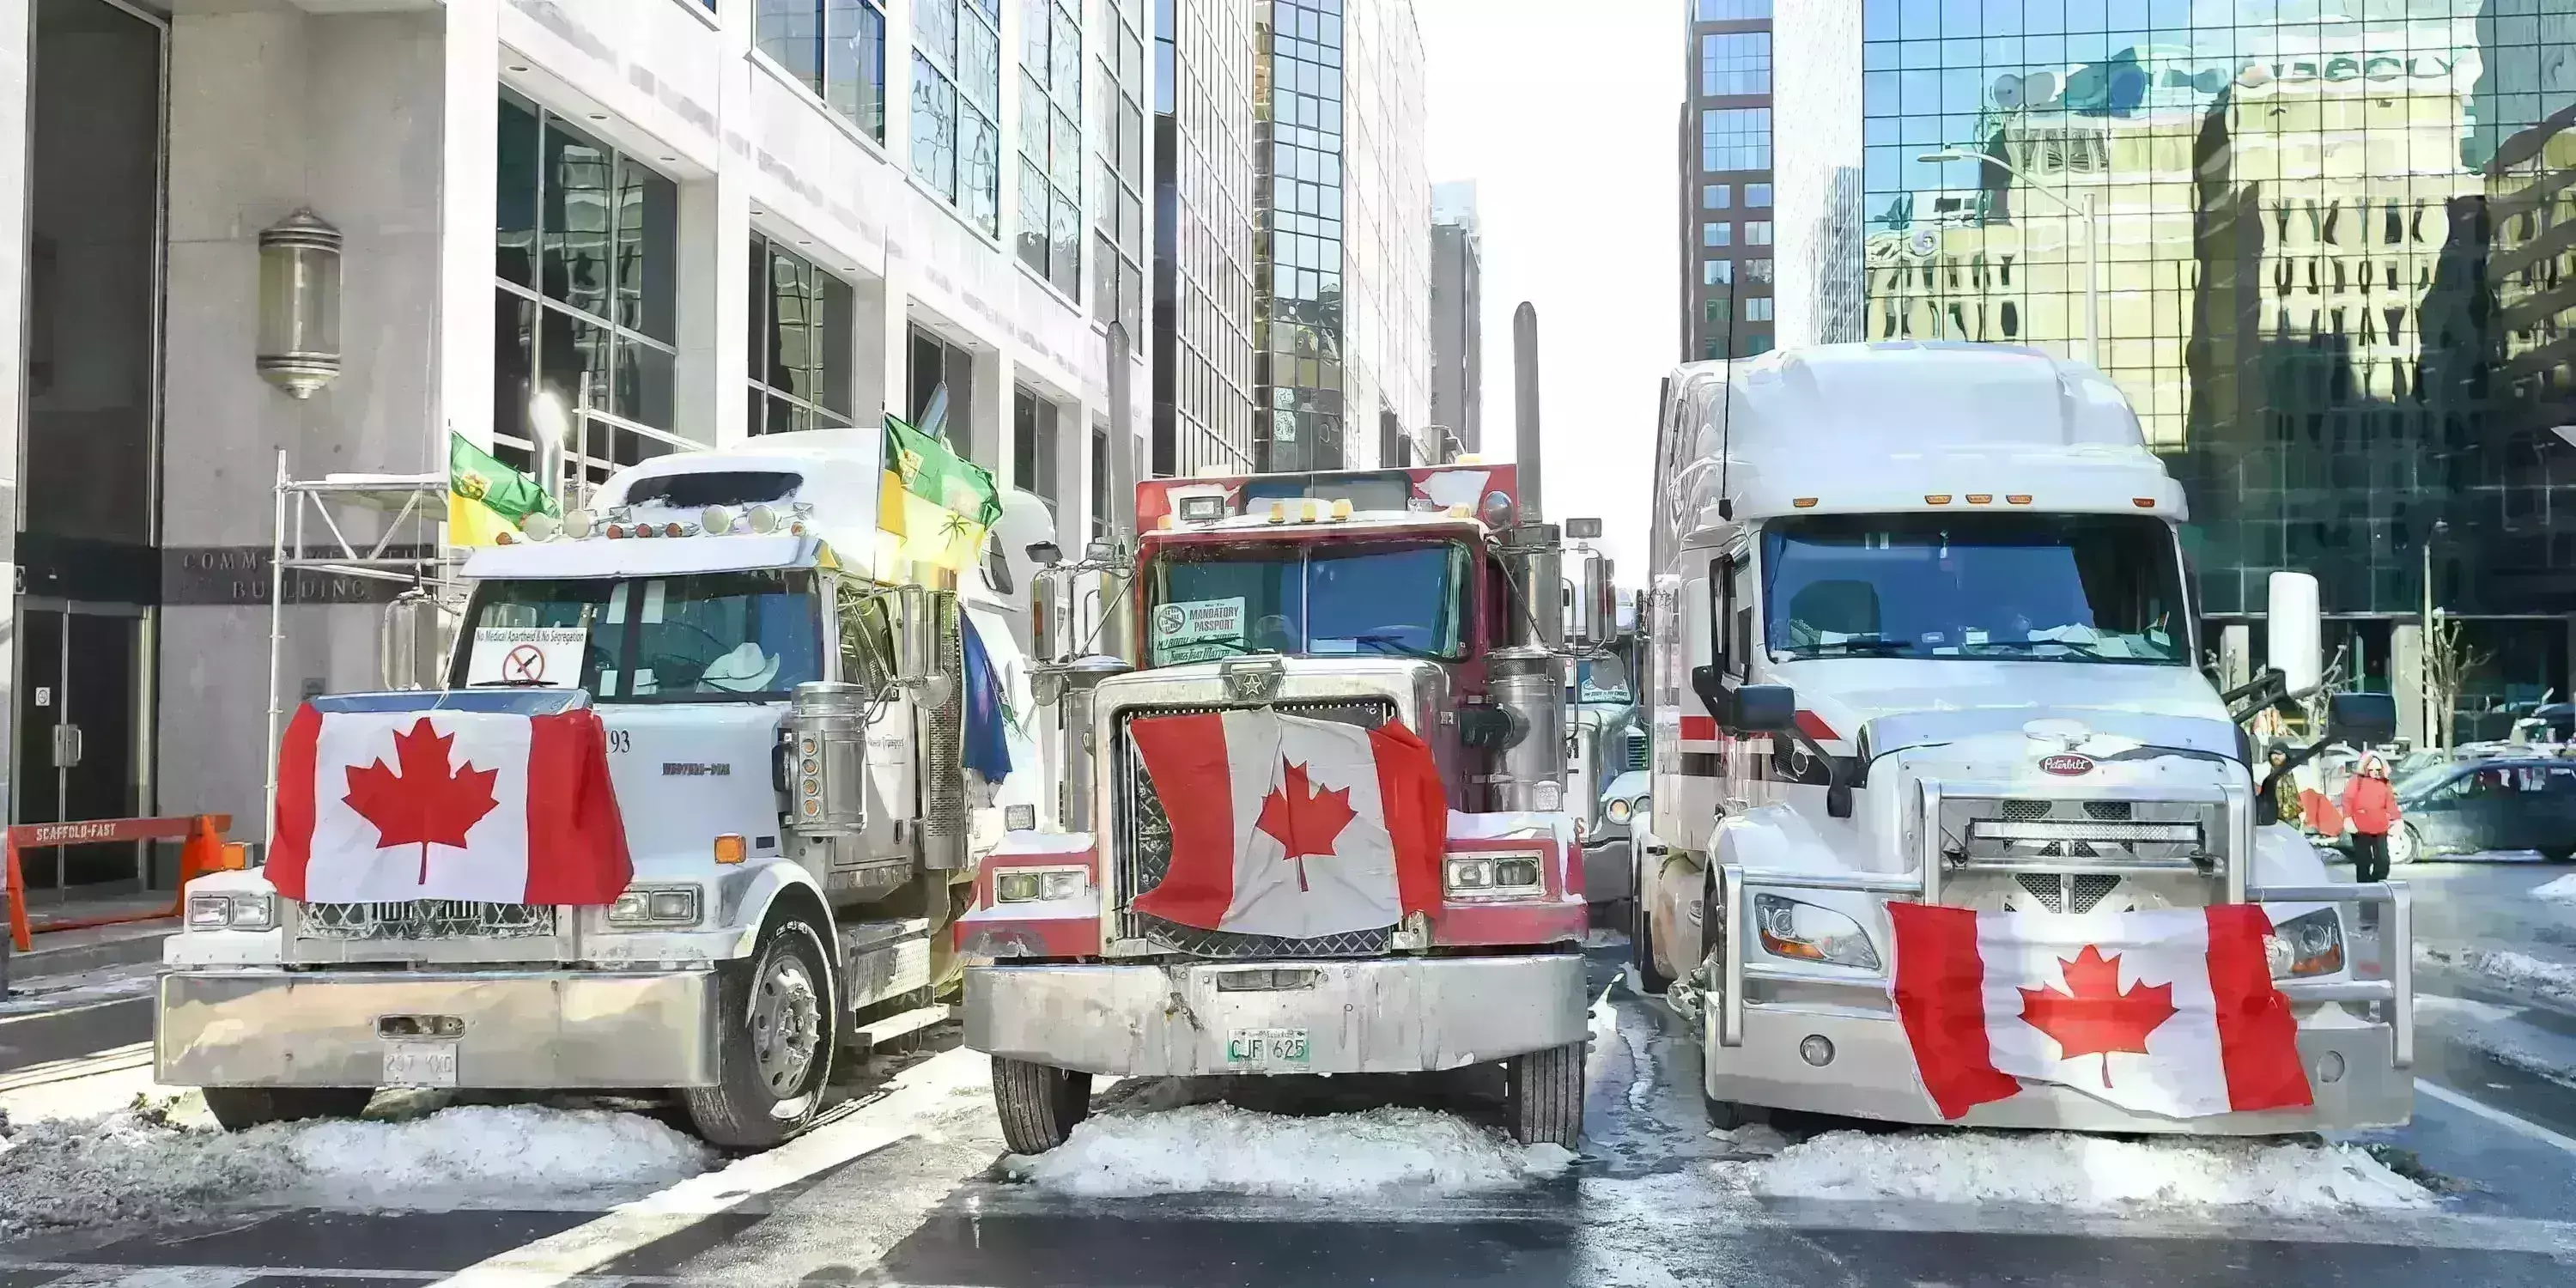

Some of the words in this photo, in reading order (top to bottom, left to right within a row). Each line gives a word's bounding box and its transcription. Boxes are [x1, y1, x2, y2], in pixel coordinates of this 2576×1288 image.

[233, 579, 367, 599] BULDING
[1189, 606, 1239, 620] MANDATORY
[1194, 619, 1234, 632] PASSPORT
[477, 630, 484, 641] No
[485, 630, 507, 642] Medical
[507, 629, 537, 643] Apartheid
[542, 630, 550, 642] No
[550, 630, 584, 645] Segregation
[2044, 757, 2089, 771] Peterbilt
[36, 823, 117, 841] SCAFFOLD-FAST
[1231, 1039, 1262, 1059] CJF
[1273, 1039, 1304, 1059] 625
